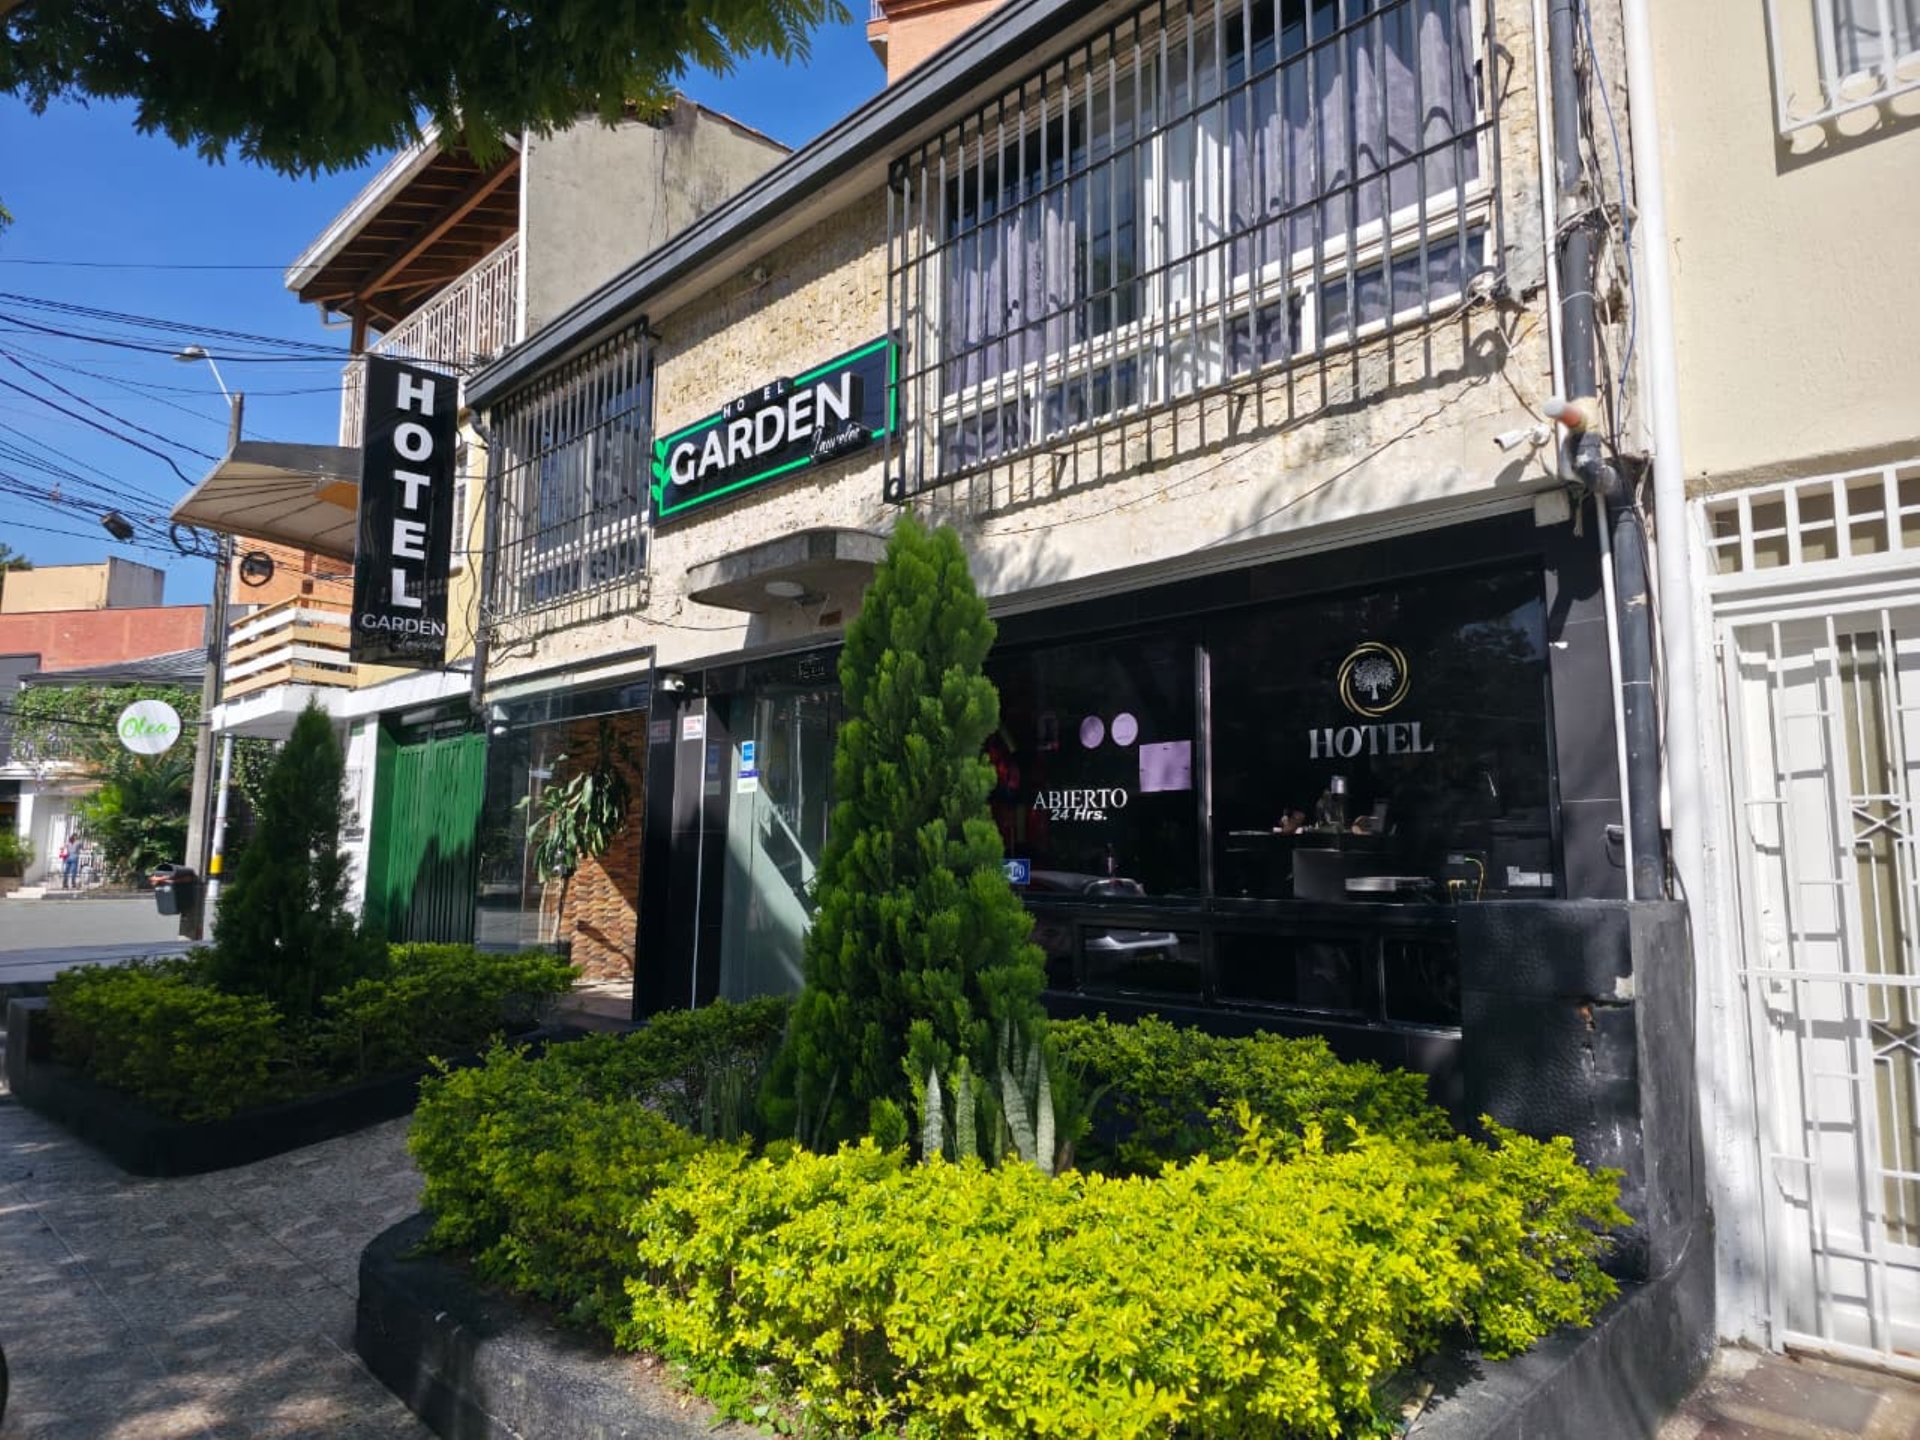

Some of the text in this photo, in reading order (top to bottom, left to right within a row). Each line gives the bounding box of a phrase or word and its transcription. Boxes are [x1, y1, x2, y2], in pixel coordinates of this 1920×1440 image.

[723, 381, 784, 419] HOEL
[669, 371, 851, 486] GARDEN
[390, 372, 436, 609] HOTEL
[361, 613, 446, 636] GARDEN
[1308, 721, 1435, 759] HOTEL
[1032, 787, 1128, 810] ABIERTO
[1050, 806, 1108, 821] 24 Hrs.
